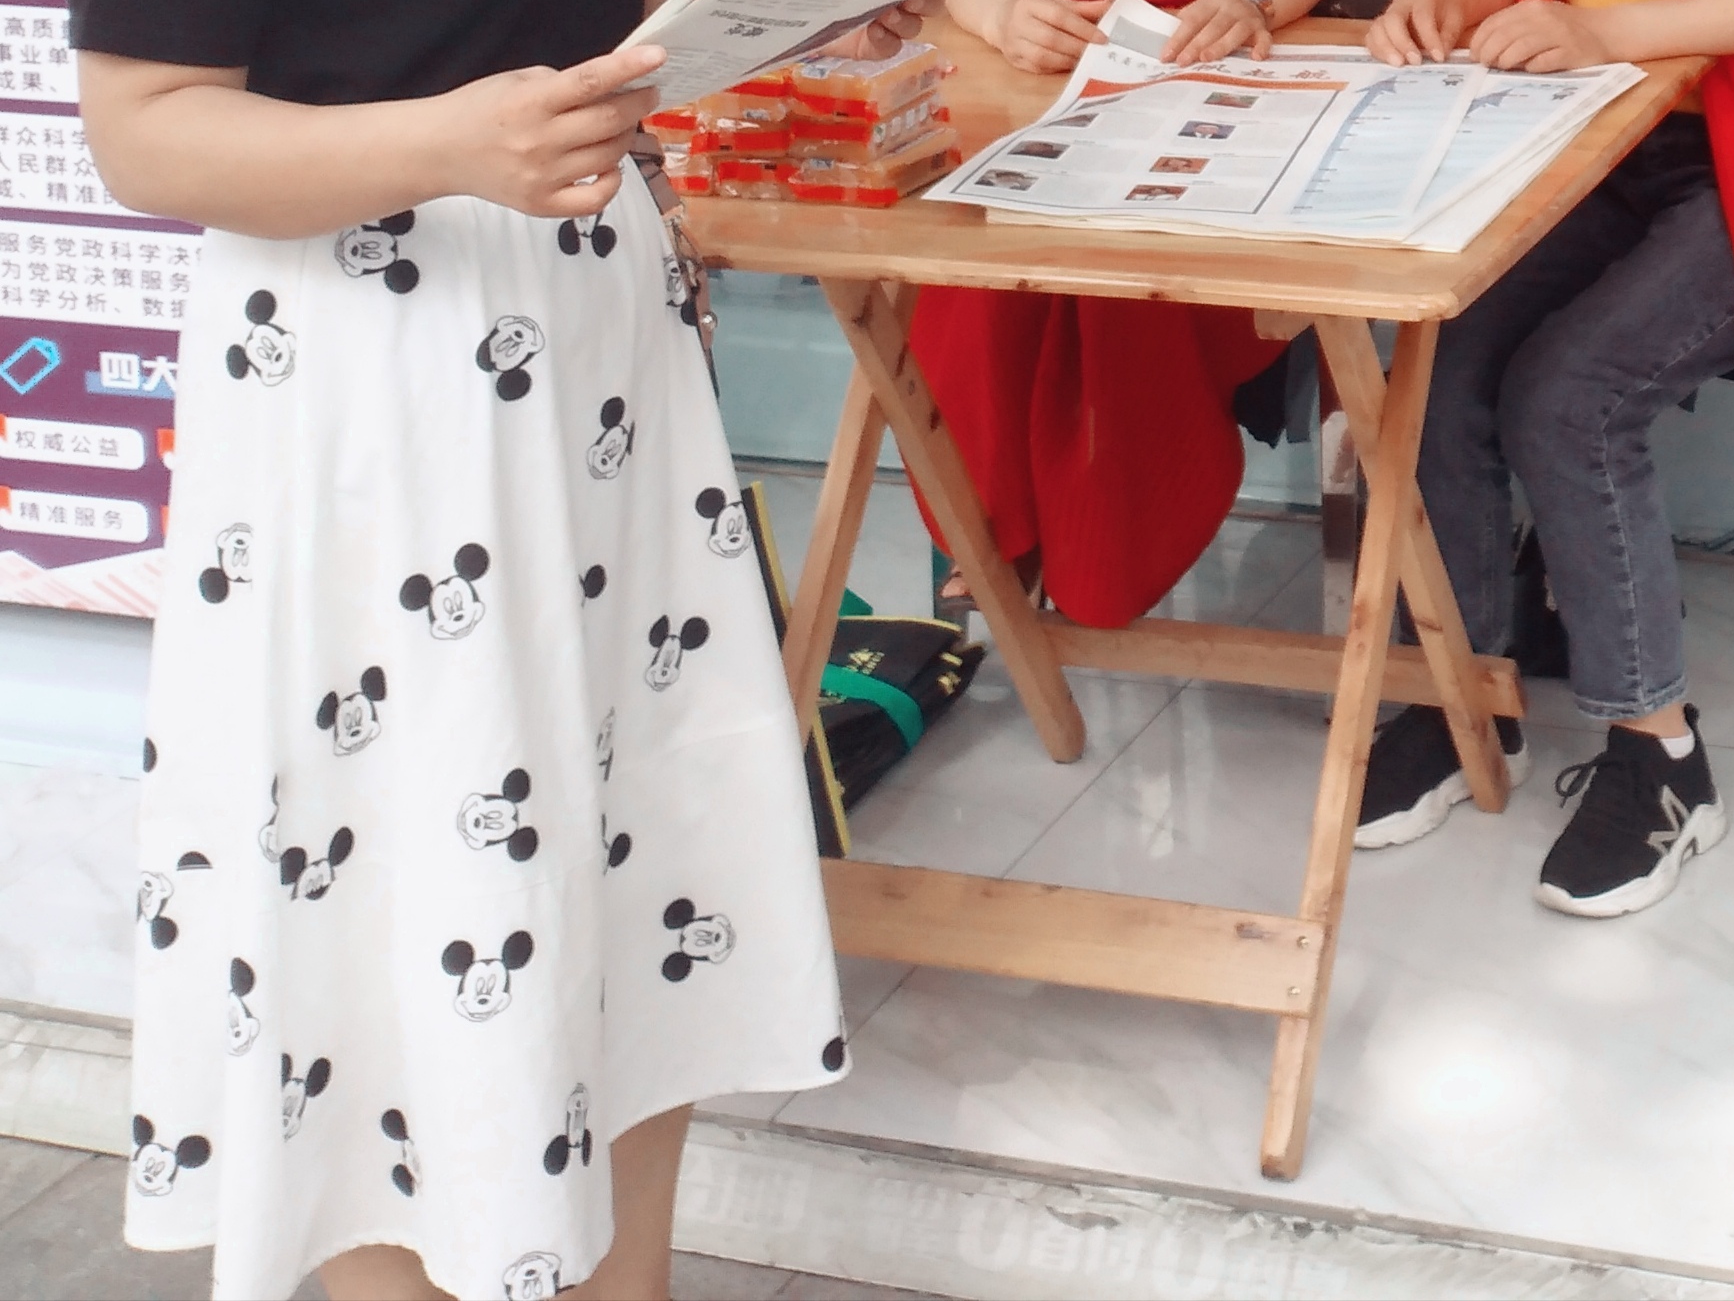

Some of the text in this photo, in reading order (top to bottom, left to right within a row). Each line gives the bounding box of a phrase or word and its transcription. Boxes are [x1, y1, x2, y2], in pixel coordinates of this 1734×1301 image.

[0, 232, 202, 267] 服务党政科学决
[2, 259, 191, 294] 为党政决策服务
[100, 351, 177, 392] 四大
[15, 429, 120, 459] 权威公益
[20, 501, 125, 531] 精准服务
